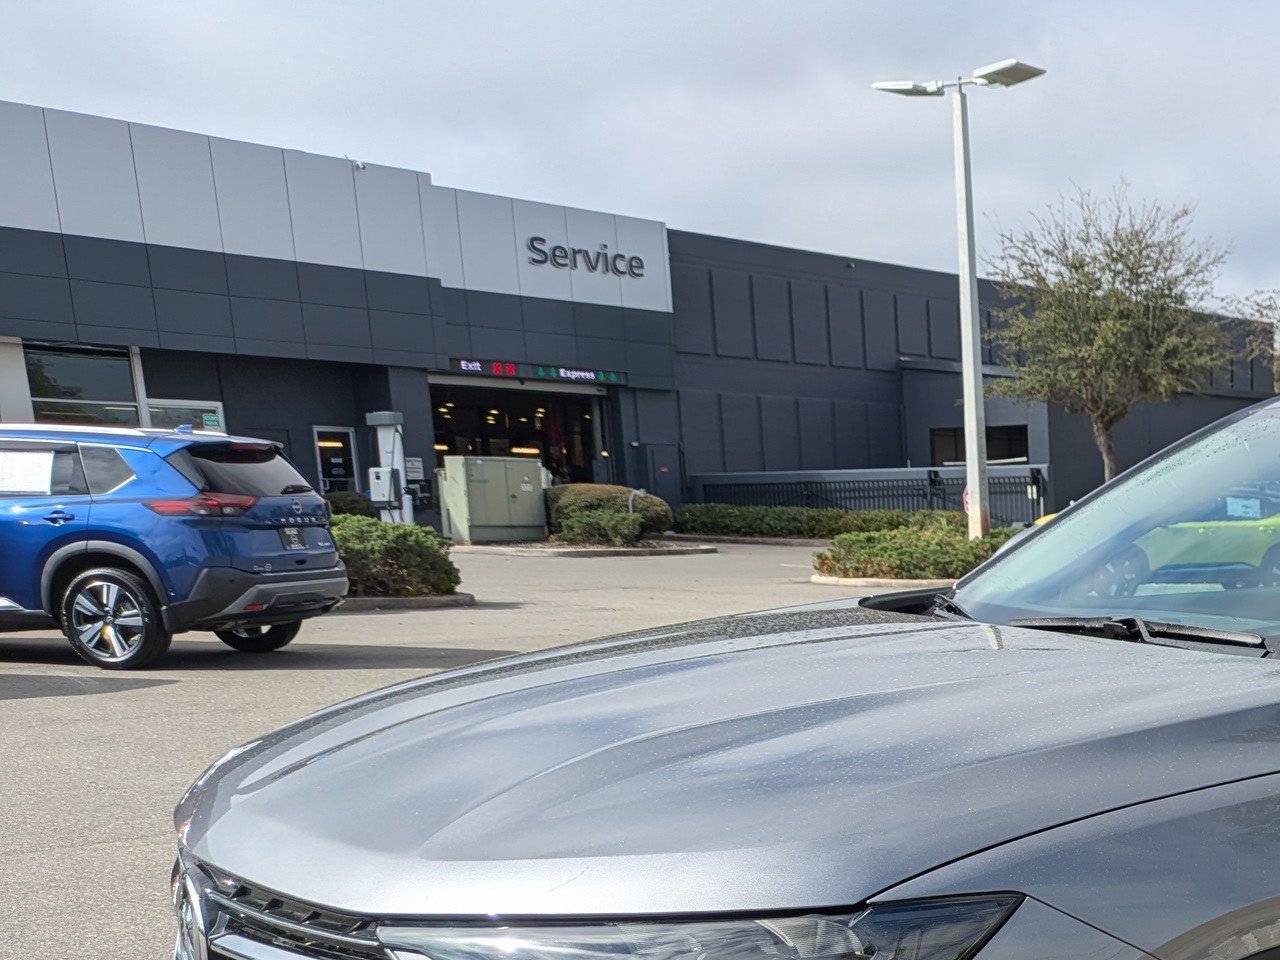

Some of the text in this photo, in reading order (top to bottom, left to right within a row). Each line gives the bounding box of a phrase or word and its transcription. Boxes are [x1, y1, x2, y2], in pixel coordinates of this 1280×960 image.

[527, 236, 645, 278] Service
[460, 360, 482, 371] Exit
[559, 368, 596, 380] Express
